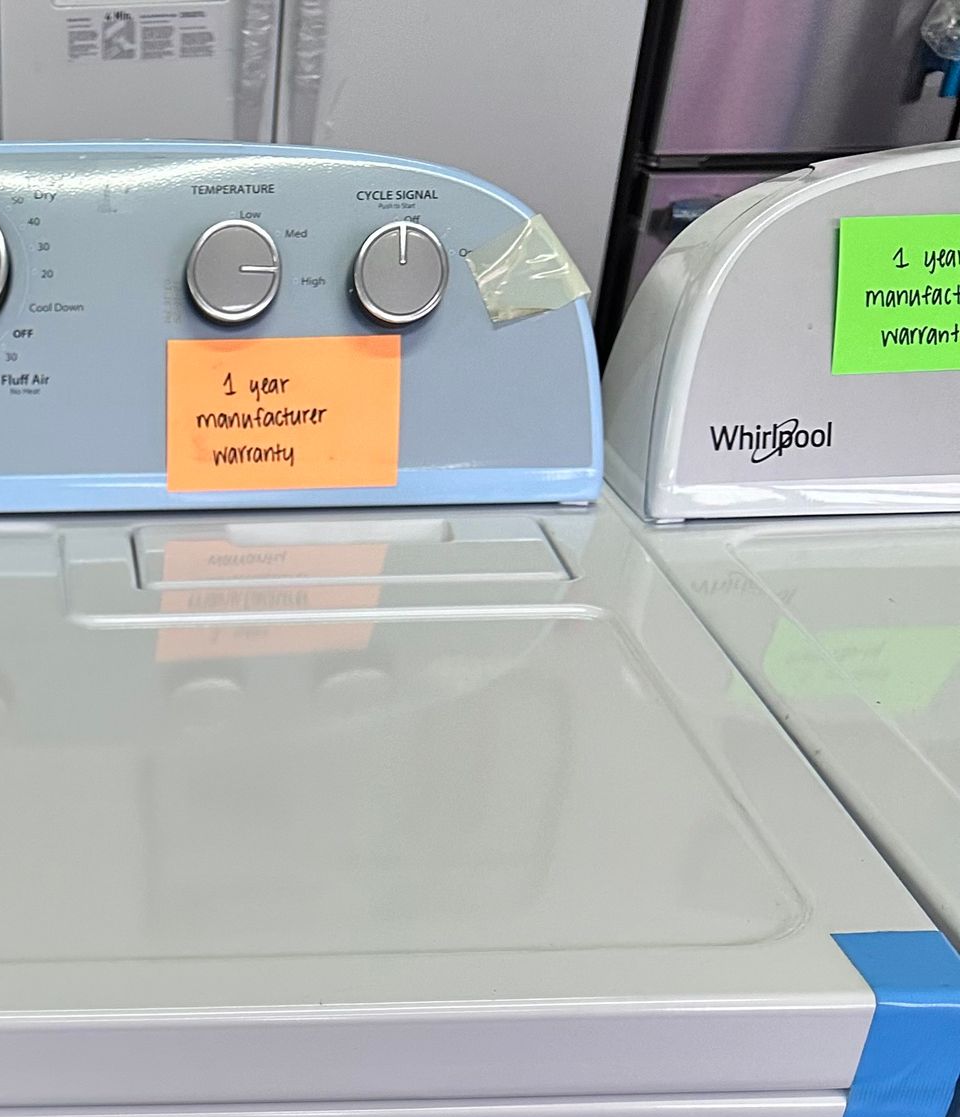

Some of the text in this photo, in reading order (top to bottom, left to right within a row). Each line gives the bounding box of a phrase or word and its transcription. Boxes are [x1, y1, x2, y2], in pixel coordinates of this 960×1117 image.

[191, 184, 275, 195] TEMPERATURE
[356, 189, 439, 201] CYCLE SIGNAL
[11, 196, 25, 205] 50
[33, 189, 57, 202] Dry
[239, 210, 262, 219] Low
[403, 215, 421, 224] Off
[27, 216, 41, 226] 40
[284, 229, 308, 239] Med
[37, 242, 51, 251] 30
[892, 247, 960, 275] 1 yea
[41, 269, 54, 279] 20
[300, 276, 326, 288] High
[28, 302, 85, 313] Cool Down
[12, 329, 34, 339] OFF
[5, 352, 18, 362] 30
[0, 374, 50, 387] Fluff Air
[223, 372, 290, 402] 1 year
[196, 407, 327, 429] manufacturer
[710, 419, 833, 463] Whirlpool
[213, 443, 294, 467] warranty
